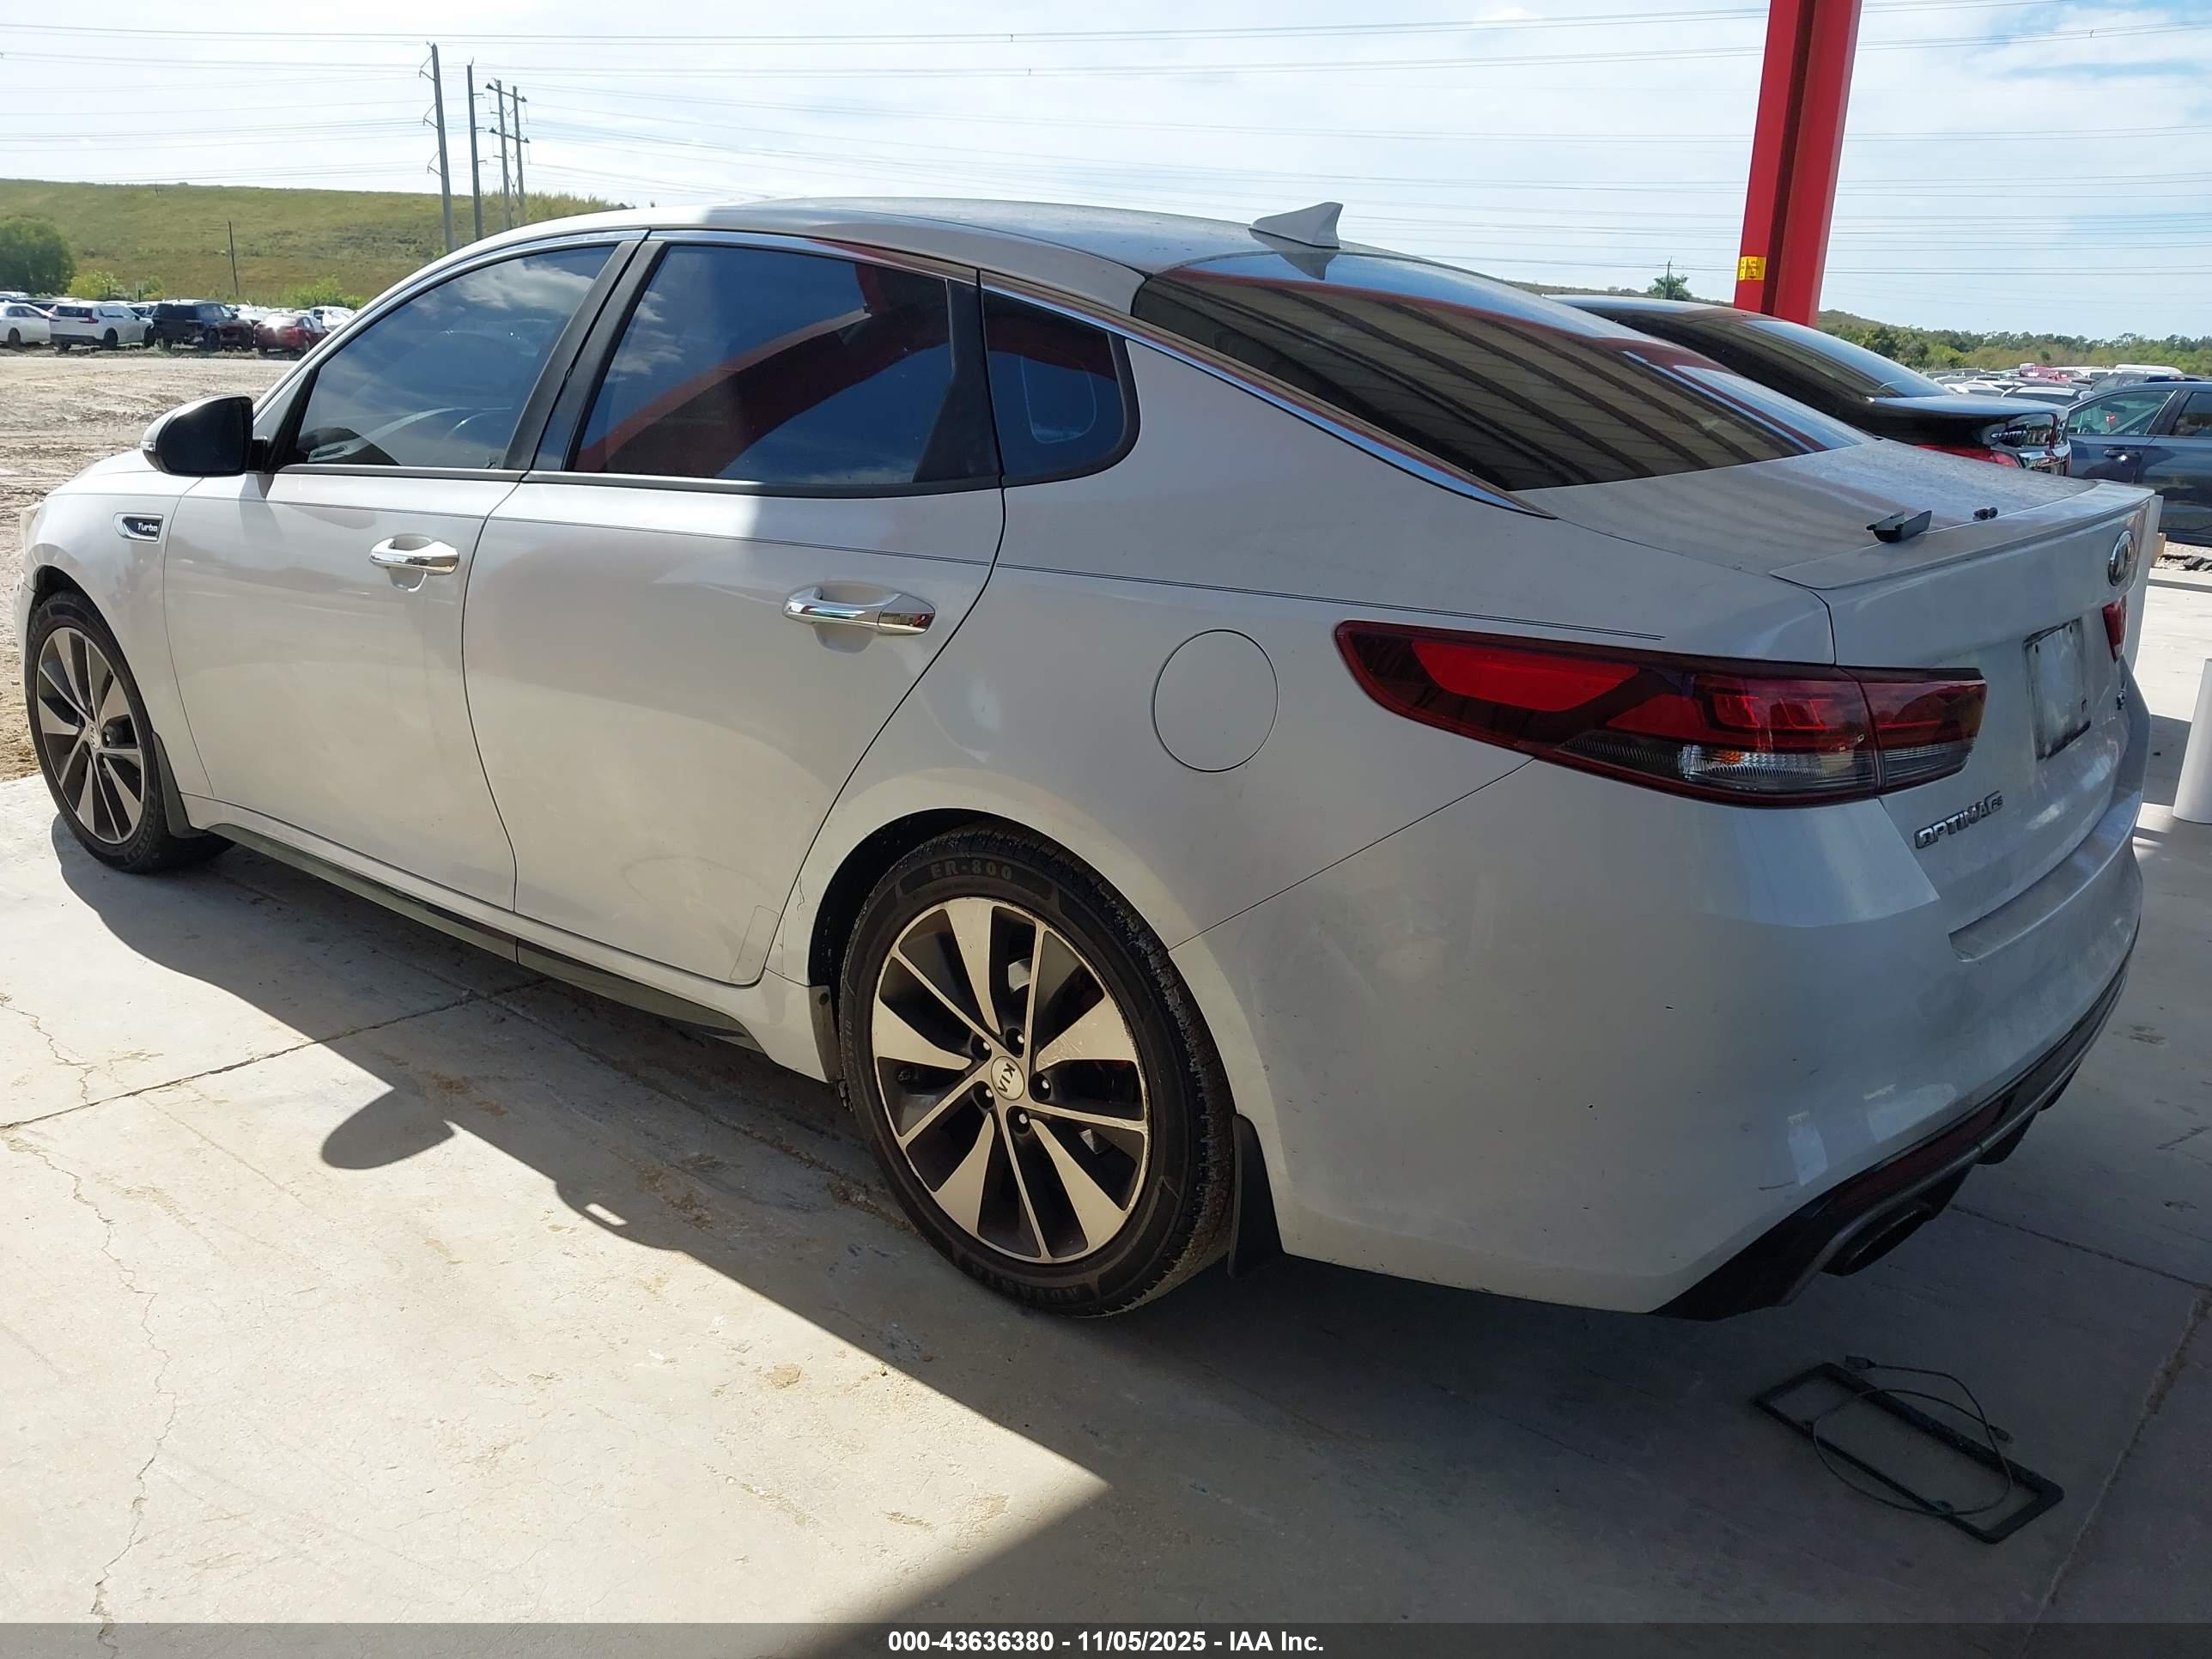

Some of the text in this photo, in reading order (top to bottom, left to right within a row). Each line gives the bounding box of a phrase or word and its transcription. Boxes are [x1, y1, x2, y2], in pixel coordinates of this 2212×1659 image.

[137, 521, 158, 532] Turbo
[1914, 801, 1990, 849] OPTIMA
[930, 860, 1013, 881] ER-800
[997, 1062, 1017, 1094] KIA
